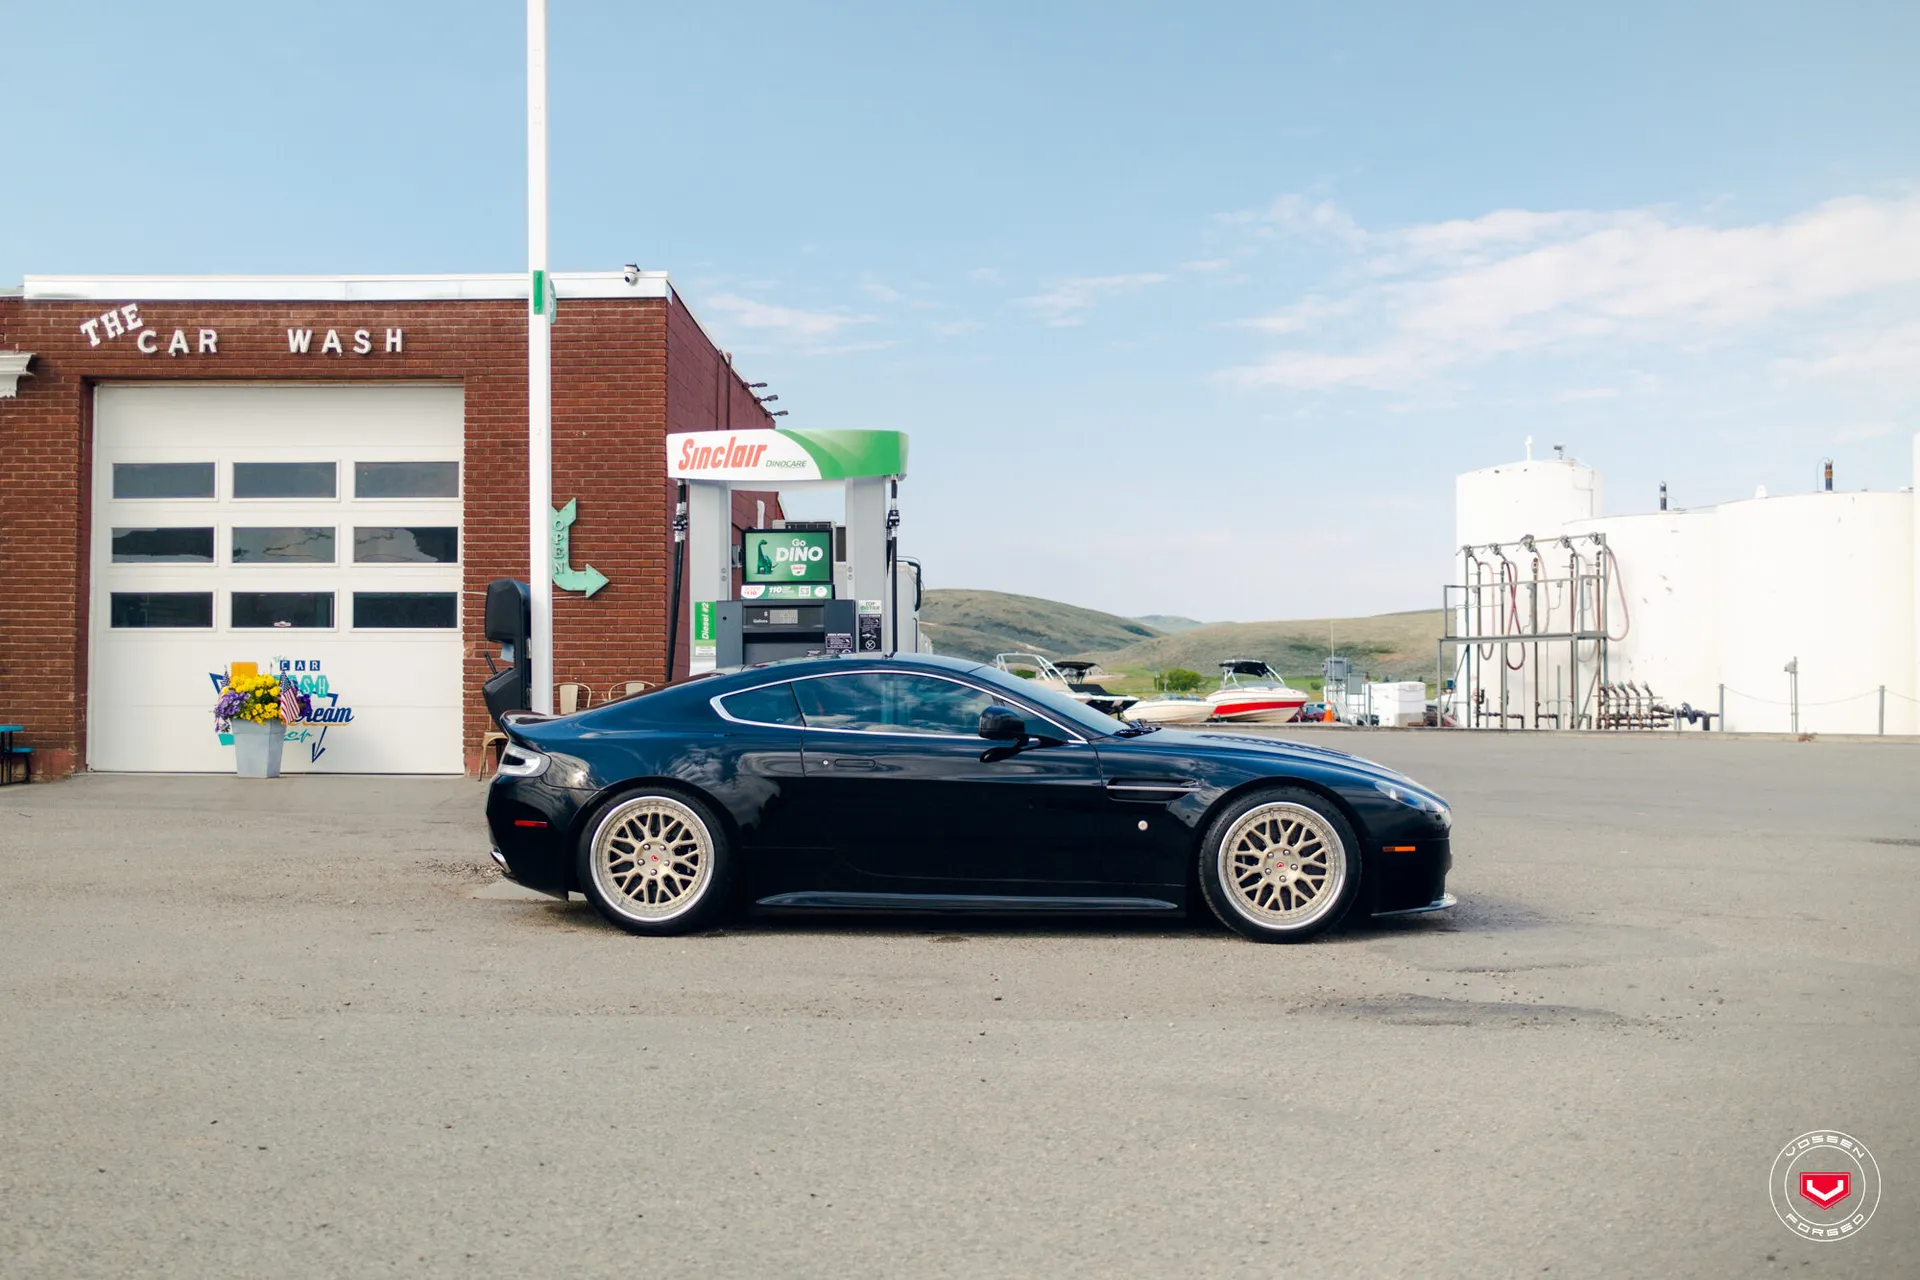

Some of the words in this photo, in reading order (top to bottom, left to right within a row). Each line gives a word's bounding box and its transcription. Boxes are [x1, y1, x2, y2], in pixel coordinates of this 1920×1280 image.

[79, 303, 144, 347] THE
[137, 328, 218, 354] CAR
[287, 328, 403, 354] WASH
[678, 436, 768, 471] Sinclair
[554, 520, 565, 574] OPEN
[776, 547, 823, 561] DINO
[792, 538, 807, 547] Go
[701, 614, 710, 640] Diesel
[281, 661, 319, 671] CAR
[295, 707, 354, 723] ream
